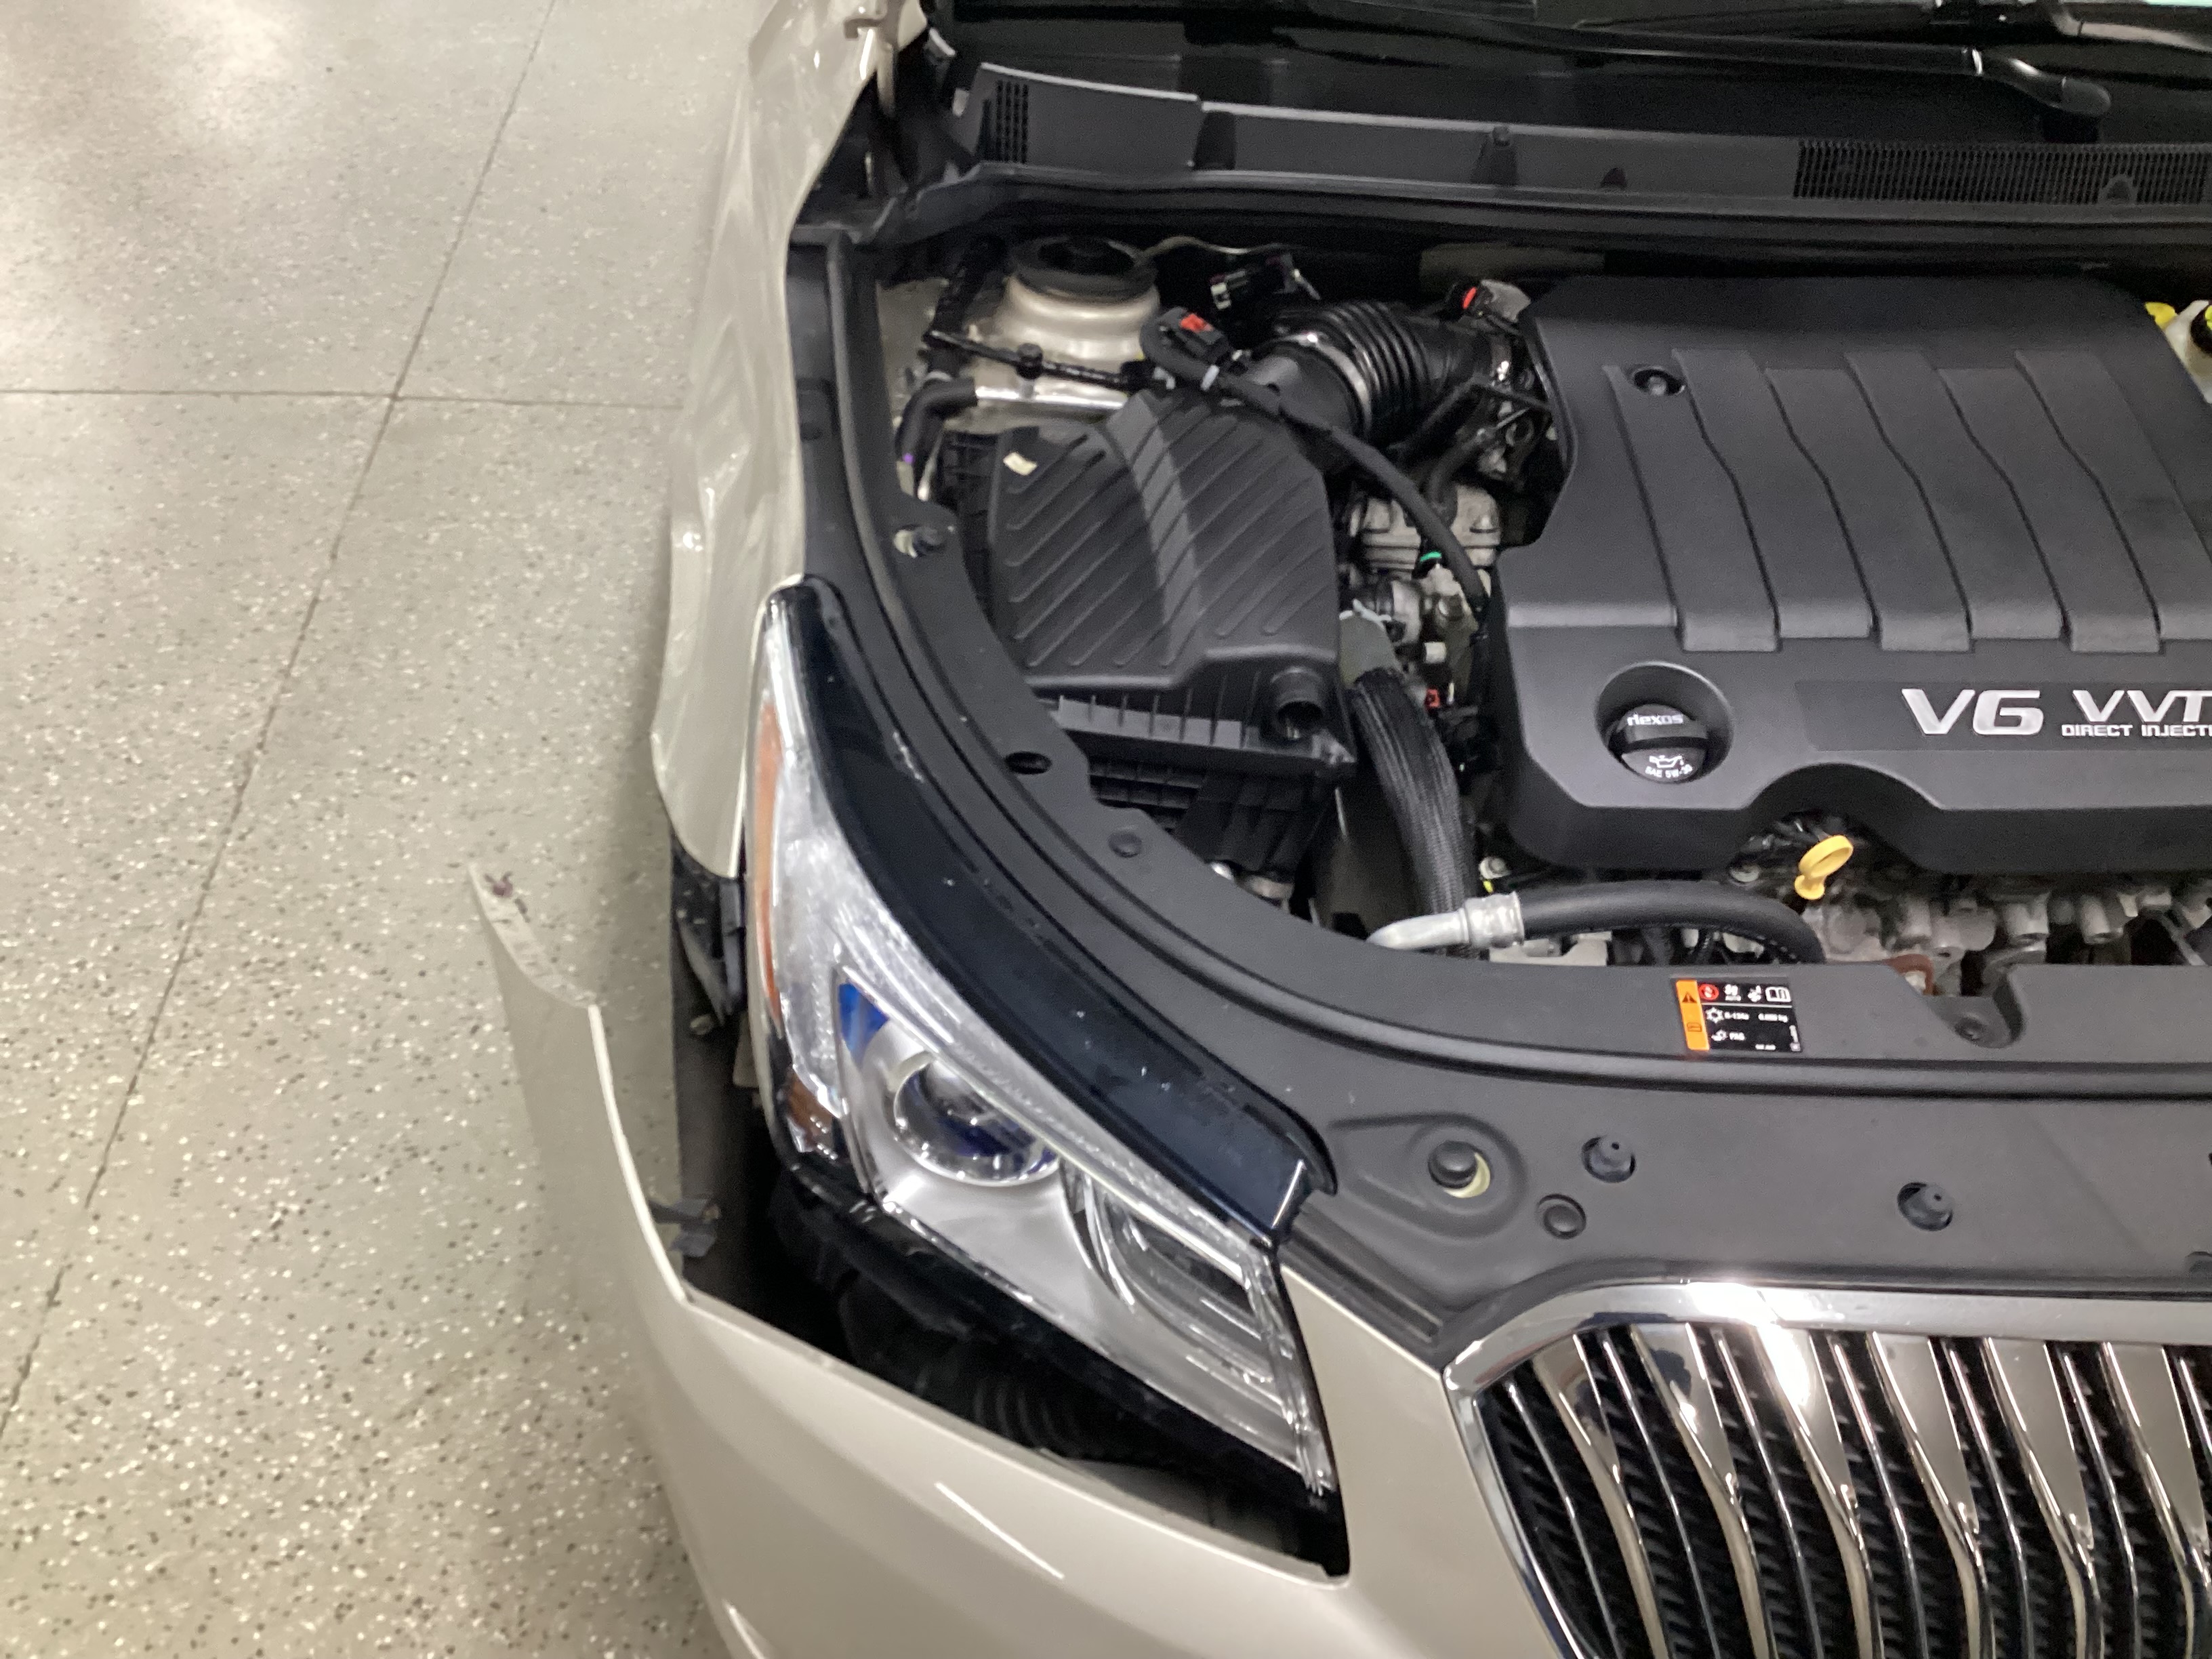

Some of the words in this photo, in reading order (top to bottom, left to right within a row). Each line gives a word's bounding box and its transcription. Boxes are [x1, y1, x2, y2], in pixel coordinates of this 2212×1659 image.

[1901, 689, 2044, 735] V6
[2072, 690, 2212, 722] VVT
[2062, 724, 2133, 737] DIRECT
